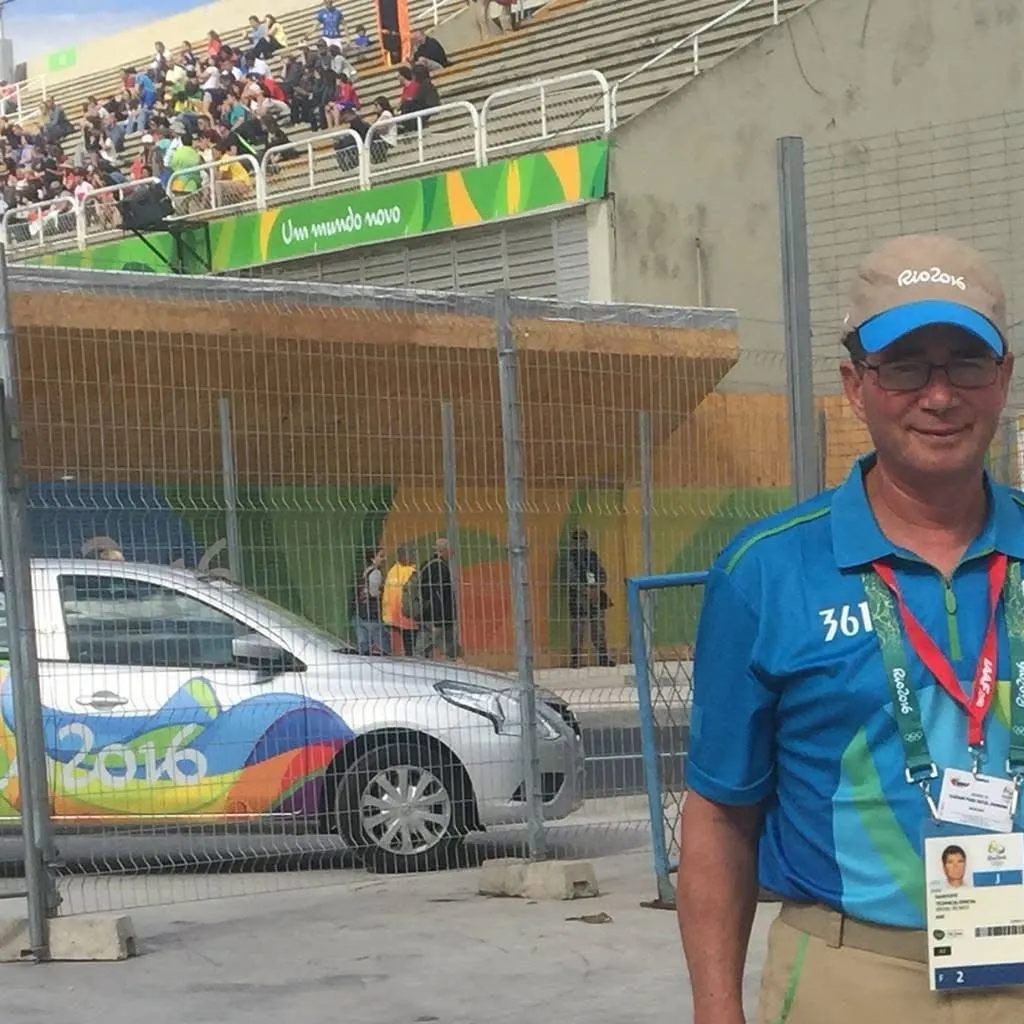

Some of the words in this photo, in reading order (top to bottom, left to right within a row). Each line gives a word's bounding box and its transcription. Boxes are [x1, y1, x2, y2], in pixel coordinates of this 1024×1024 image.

[282, 219, 309, 245] Um
[311, 206, 362, 238] mundo
[364, 205, 401, 228] novo
[898, 267, 966, 290] Rio2016
[818, 601, 873, 641] 361
[892, 668, 913, 714] Rio2016
[956, 971, 965, 984] 2
